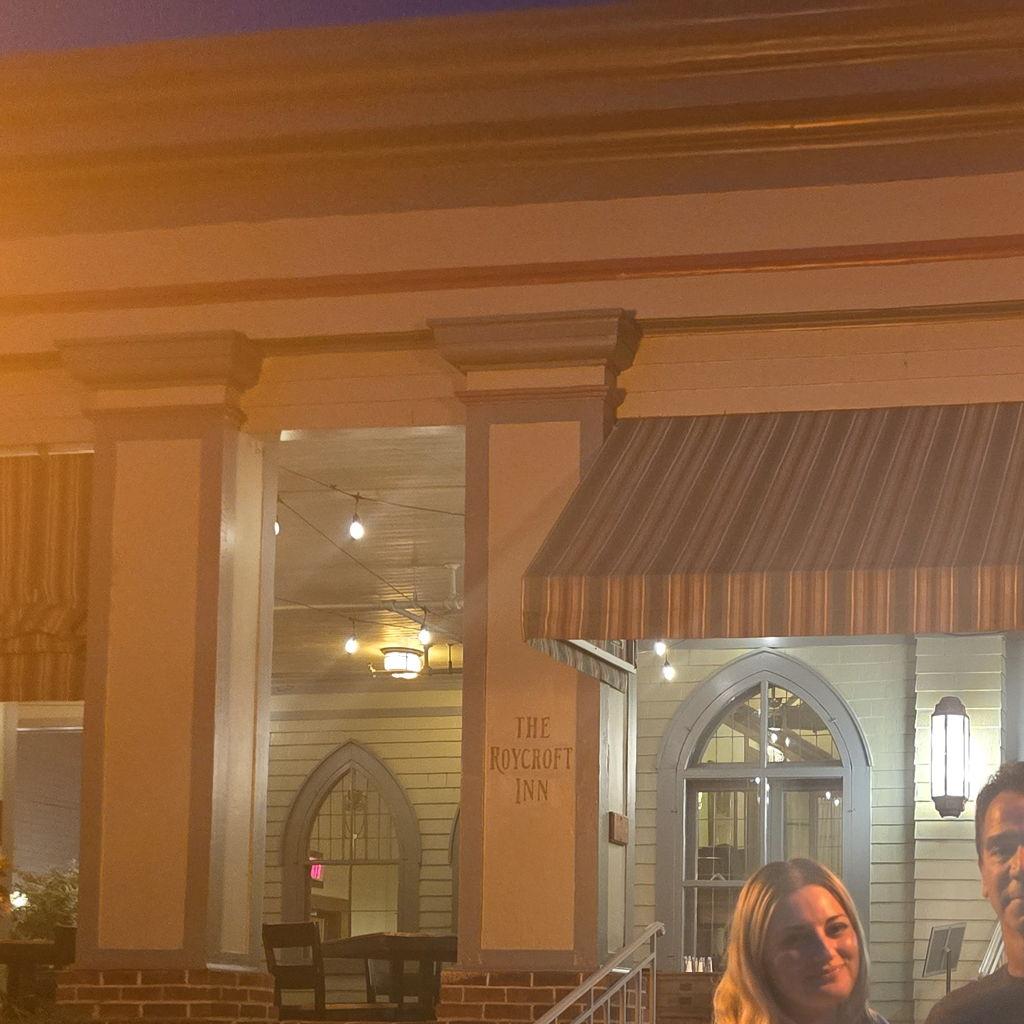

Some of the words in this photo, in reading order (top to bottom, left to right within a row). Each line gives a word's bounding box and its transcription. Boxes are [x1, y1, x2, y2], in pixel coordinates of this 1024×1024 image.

[514, 715, 551, 739] THE
[489, 746, 574, 775] ROYCROFT
[514, 777, 549, 804] INN
